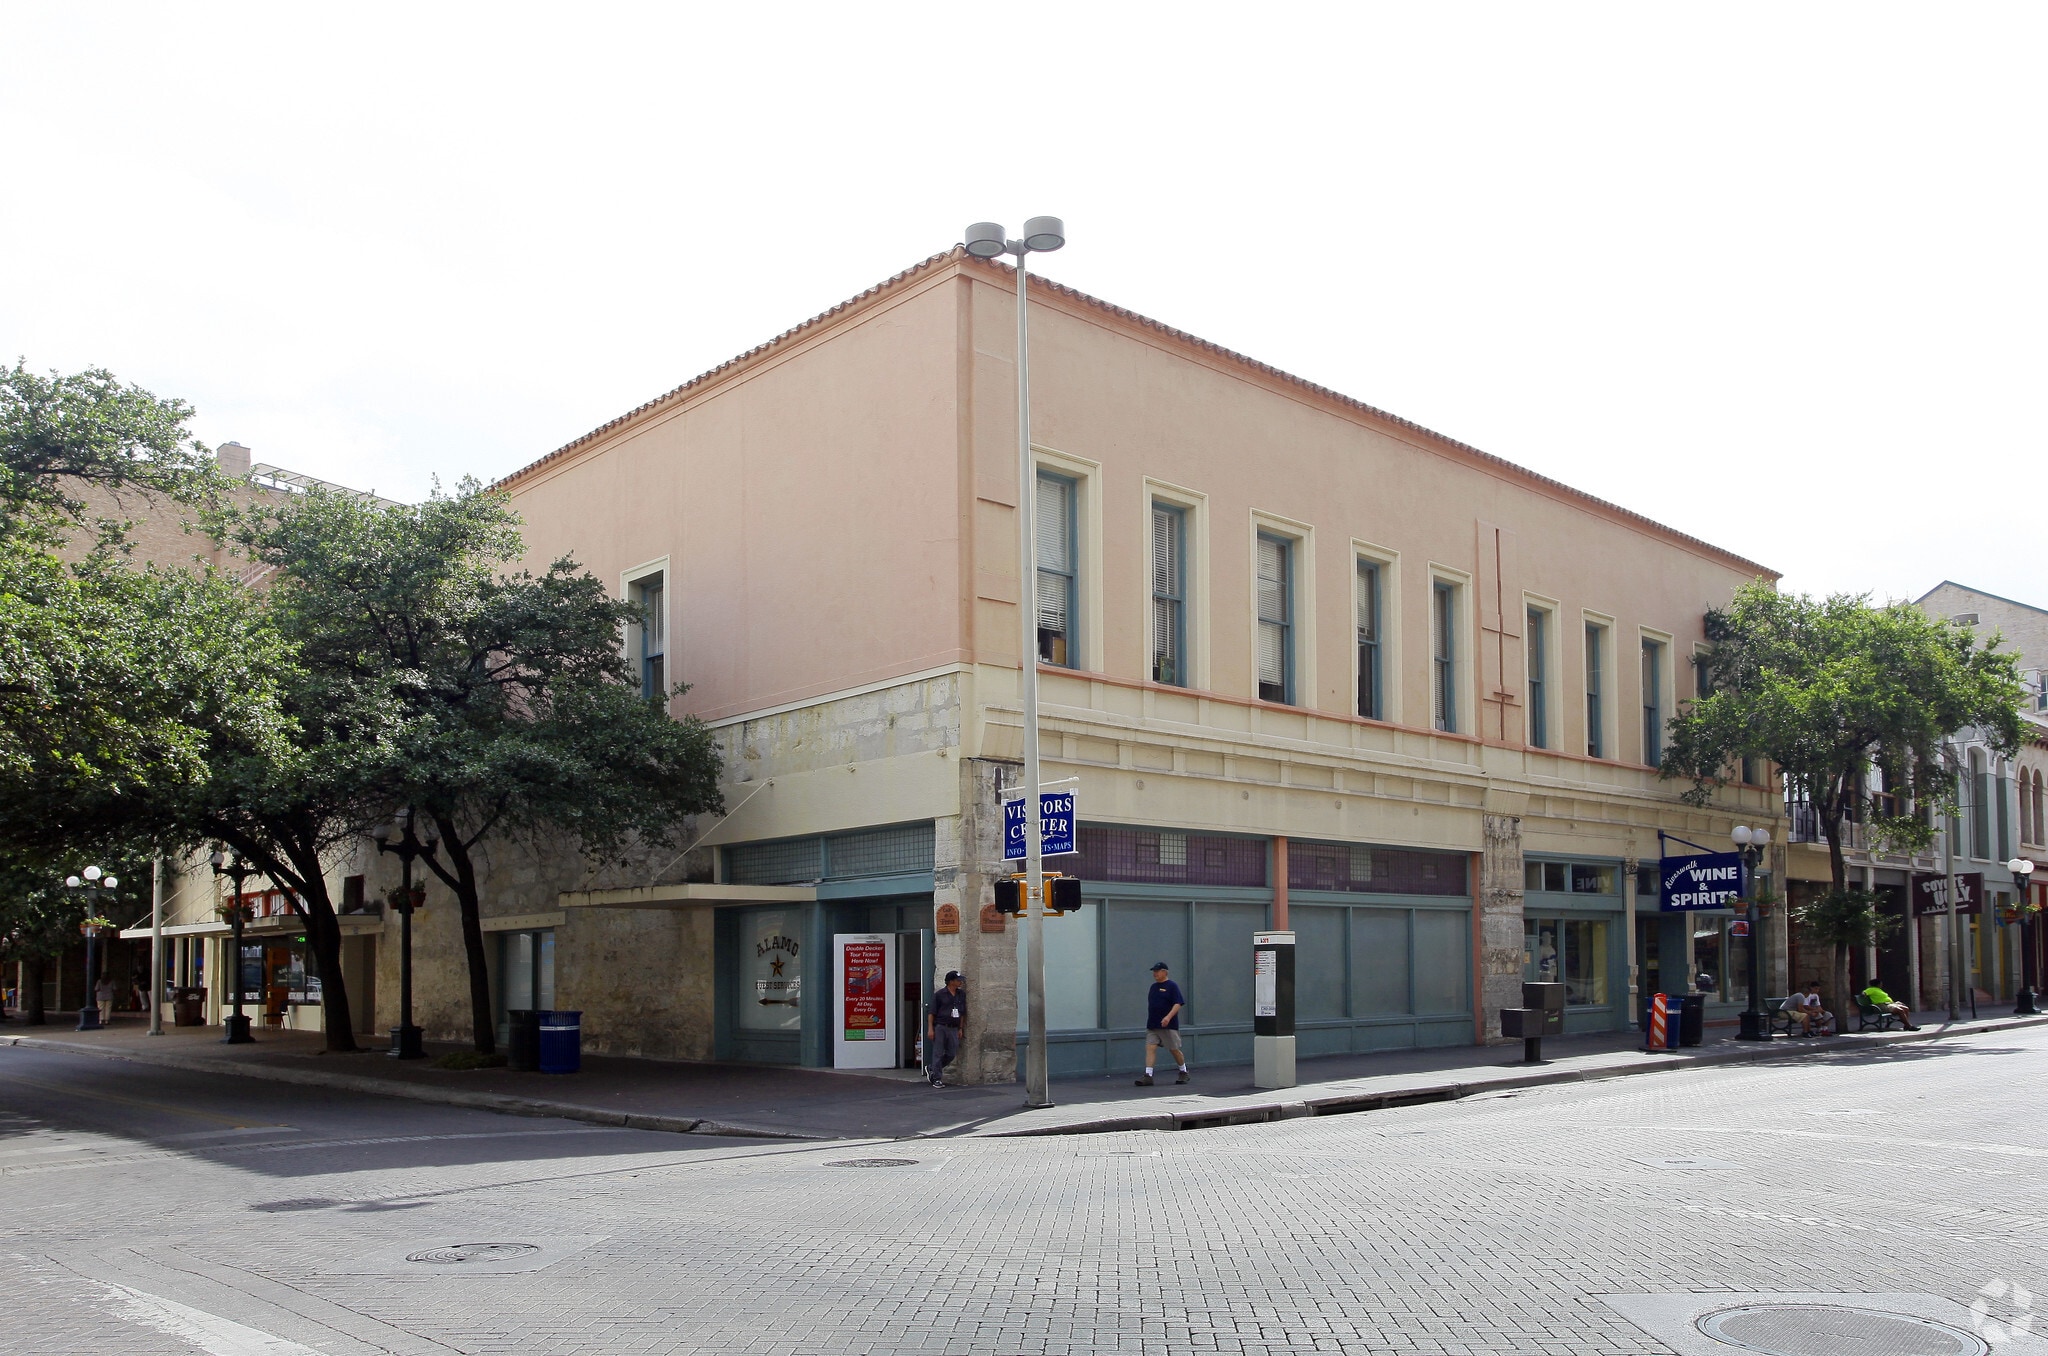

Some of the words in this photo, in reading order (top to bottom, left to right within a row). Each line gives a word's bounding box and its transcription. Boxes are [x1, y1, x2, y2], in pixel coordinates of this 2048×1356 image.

[1010, 819, 1067, 838] CETER
[1664, 860, 1698, 890] Riverwalk
[1689, 866, 1738, 882] WINE
[1699, 882, 1709, 891] &
[1670, 890, 1738, 907] SPIRITS
[757, 936, 799, 958] ALAMO
